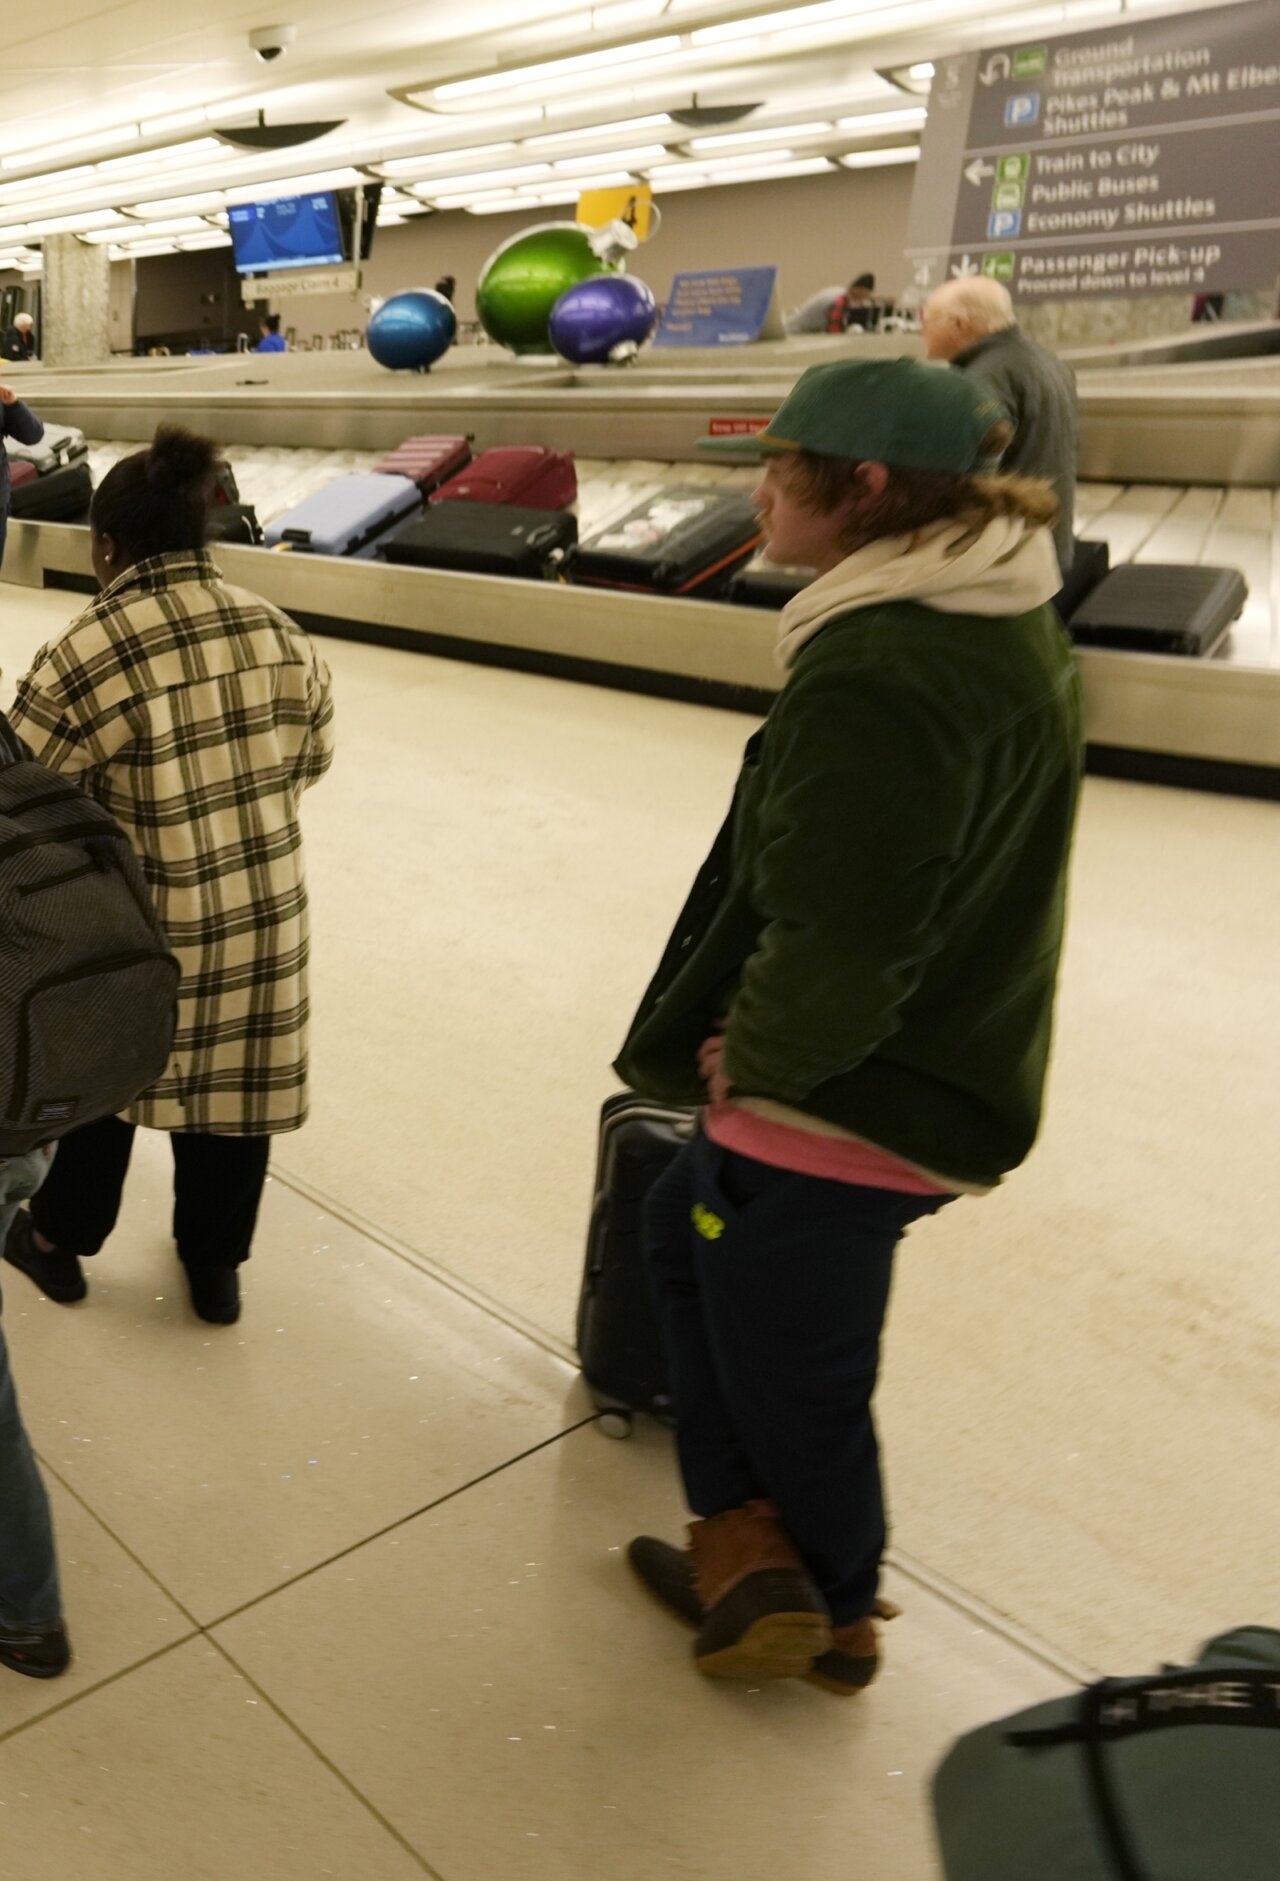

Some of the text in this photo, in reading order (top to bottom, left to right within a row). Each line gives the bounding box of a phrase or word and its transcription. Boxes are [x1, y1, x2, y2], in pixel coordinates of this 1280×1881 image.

[1054, 35, 1134, 67] Ground
[1054, 48, 1210, 88] Transportation
[1046, 64, 1280, 115] Pikes Peak & Mt Elbe
[1043, 109, 1128, 138] Shuttles
[1036, 143, 1160, 175] Train to City
[1032, 174, 1159, 204] Public Buses
[1027, 196, 1215, 233] Economy Shuttles
[1021, 243, 1220, 275] Passenger Pick-up
[1018, 266, 1206, 294] Proceed down to level 4
